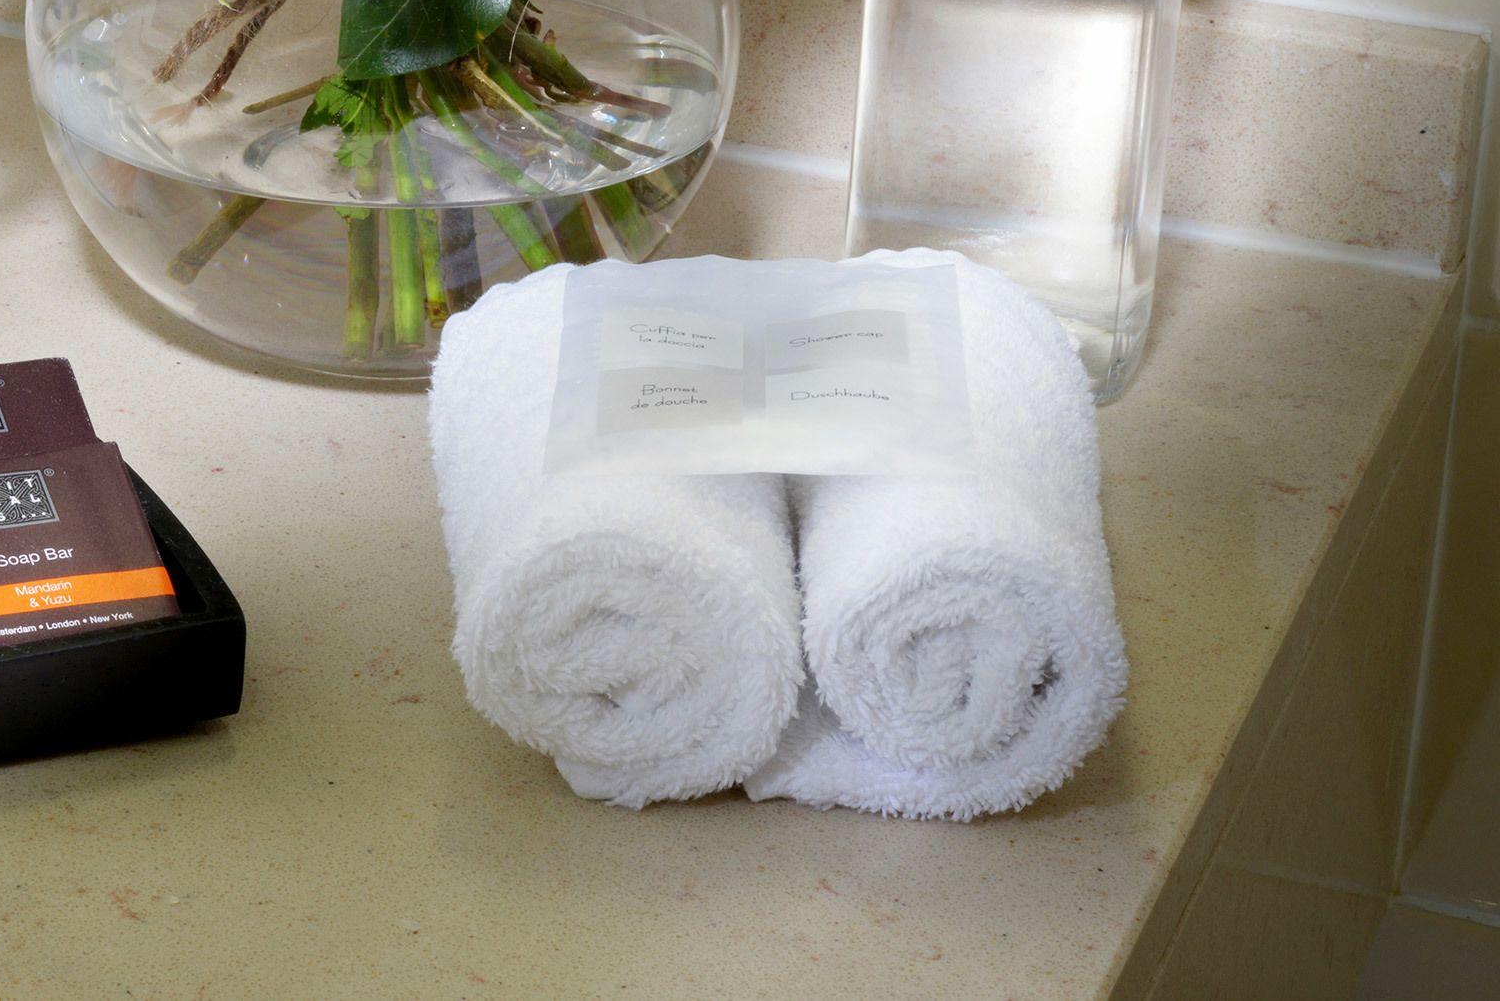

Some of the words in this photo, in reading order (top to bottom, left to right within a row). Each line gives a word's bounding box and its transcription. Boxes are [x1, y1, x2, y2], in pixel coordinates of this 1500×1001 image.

[629, 324, 685, 336] Cuffia
[641, 385, 698, 395] Bonnet
[791, 388, 889, 400] Duschhaube
[630, 398, 649, 410] de
[655, 396, 707, 406] douche
[44, 547, 74, 561] Bar
[15, 581, 72, 596] Mandarin
[29, 598, 39, 608] &
[41, 594, 72, 606] Yuzu
[46, 618, 80, 630] London
[89, 614, 110, 624] New
[111, 612, 134, 620] York
